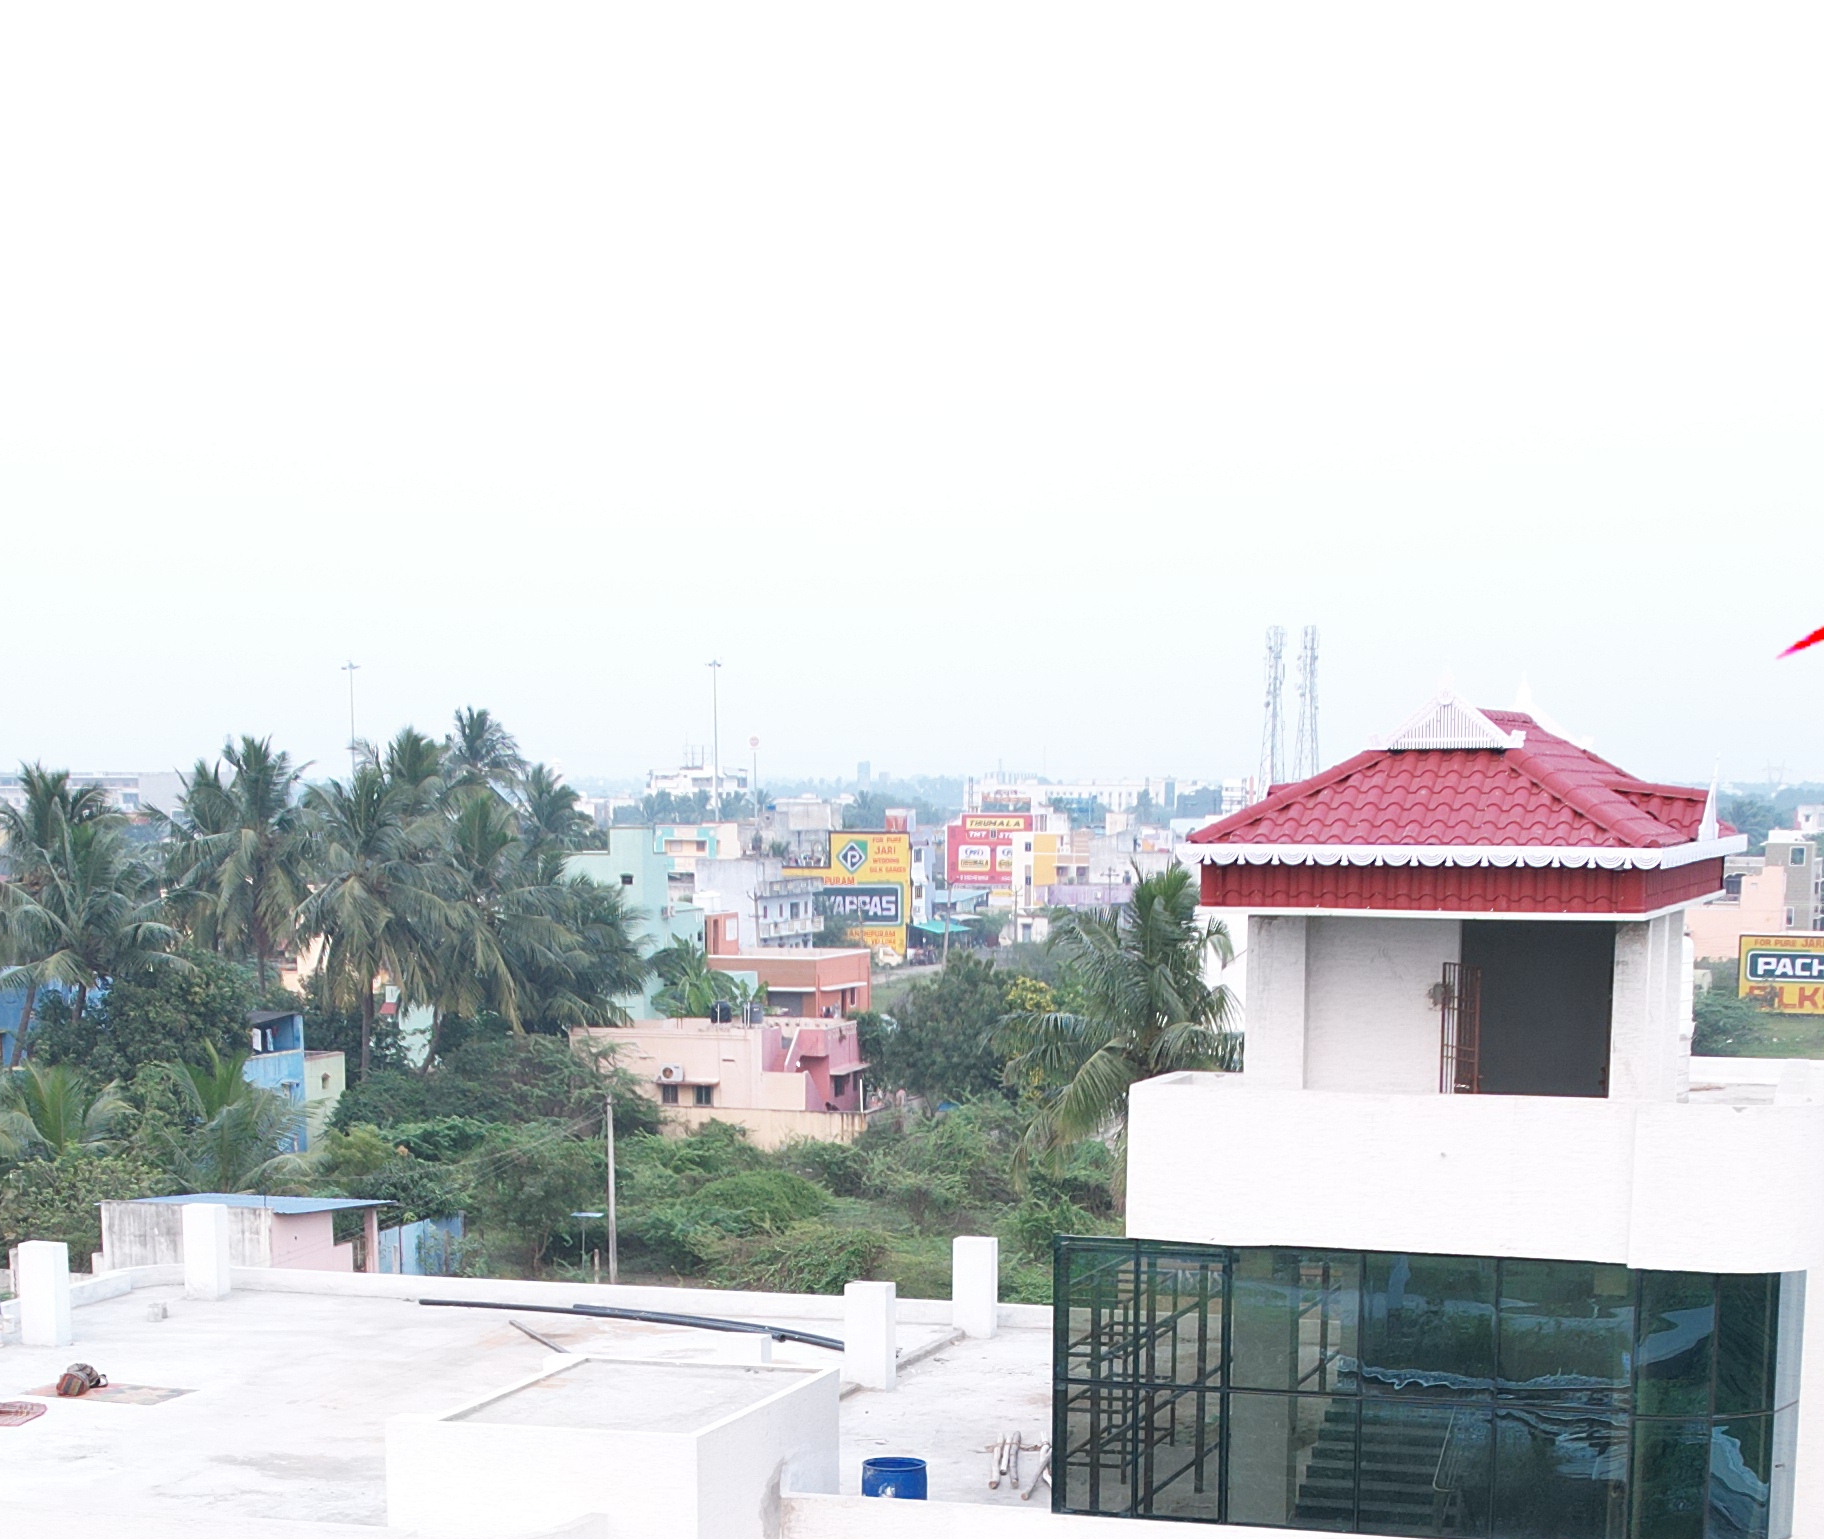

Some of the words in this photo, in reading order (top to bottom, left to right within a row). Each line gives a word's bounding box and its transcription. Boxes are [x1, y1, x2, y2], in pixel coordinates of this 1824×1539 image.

[874, 846, 896, 855] JARI
[1774, 939, 1796, 947] PURE
[1801, 938, 1824, 948] JARI
